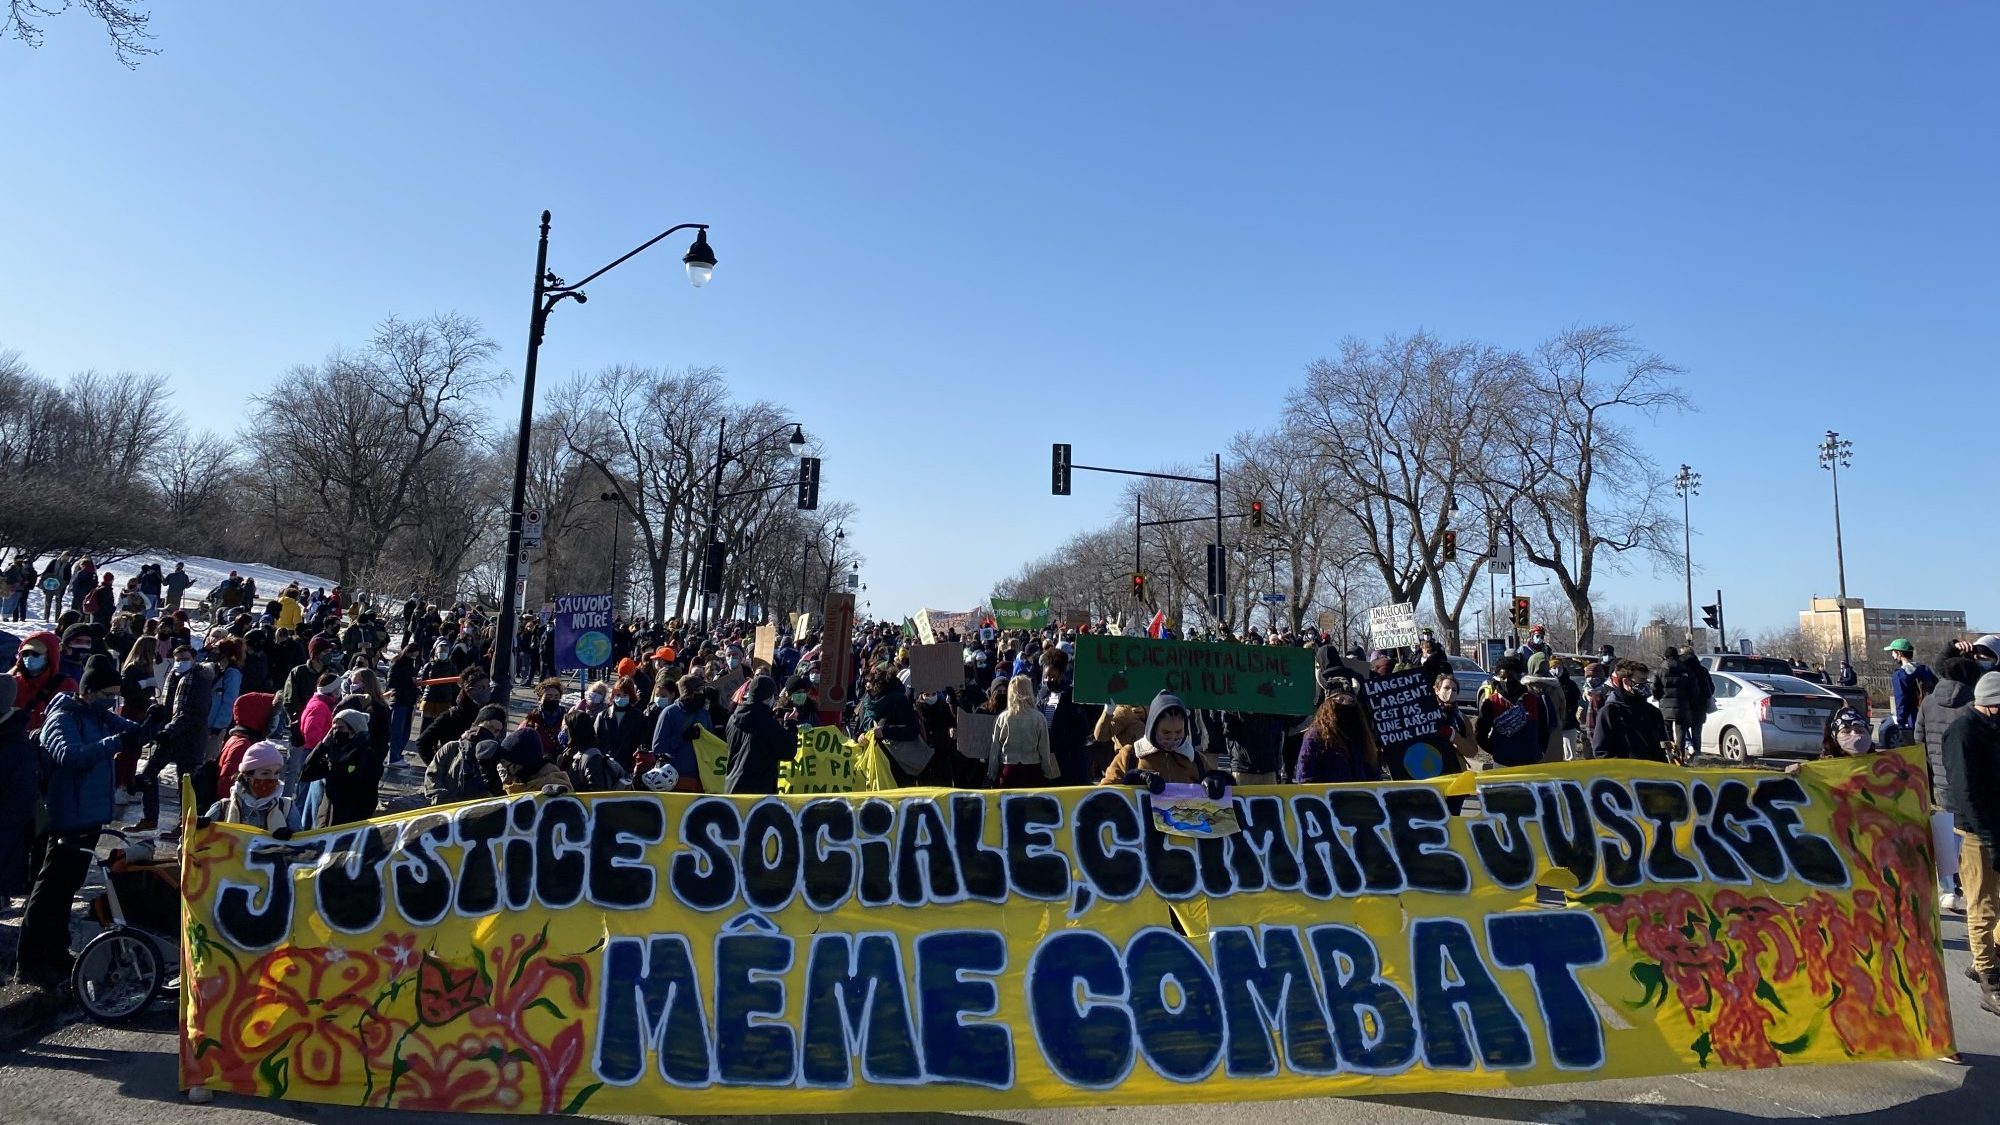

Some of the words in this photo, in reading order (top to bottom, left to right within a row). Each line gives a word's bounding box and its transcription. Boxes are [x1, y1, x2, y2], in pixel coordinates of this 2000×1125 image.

[1491, 561, 1507, 570] FIN
[556, 595, 612, 614] SAUVONS
[572, 612, 608, 630] NOTRE
[1096, 643, 1120, 666] LE
[1202, 671, 1239, 696] PUE
[1373, 708, 1399, 721] C'EST
[1402, 703, 1422, 715] PAS
[1377, 719, 1402, 733] UNE
[1404, 709, 1442, 728] RAISON
[1380, 730, 1413, 746] POUR
[1415, 722, 1438, 736] LUI
[592, 907, 1015, 1089] MÊME
[1024, 910, 1610, 1090] COMBAT
